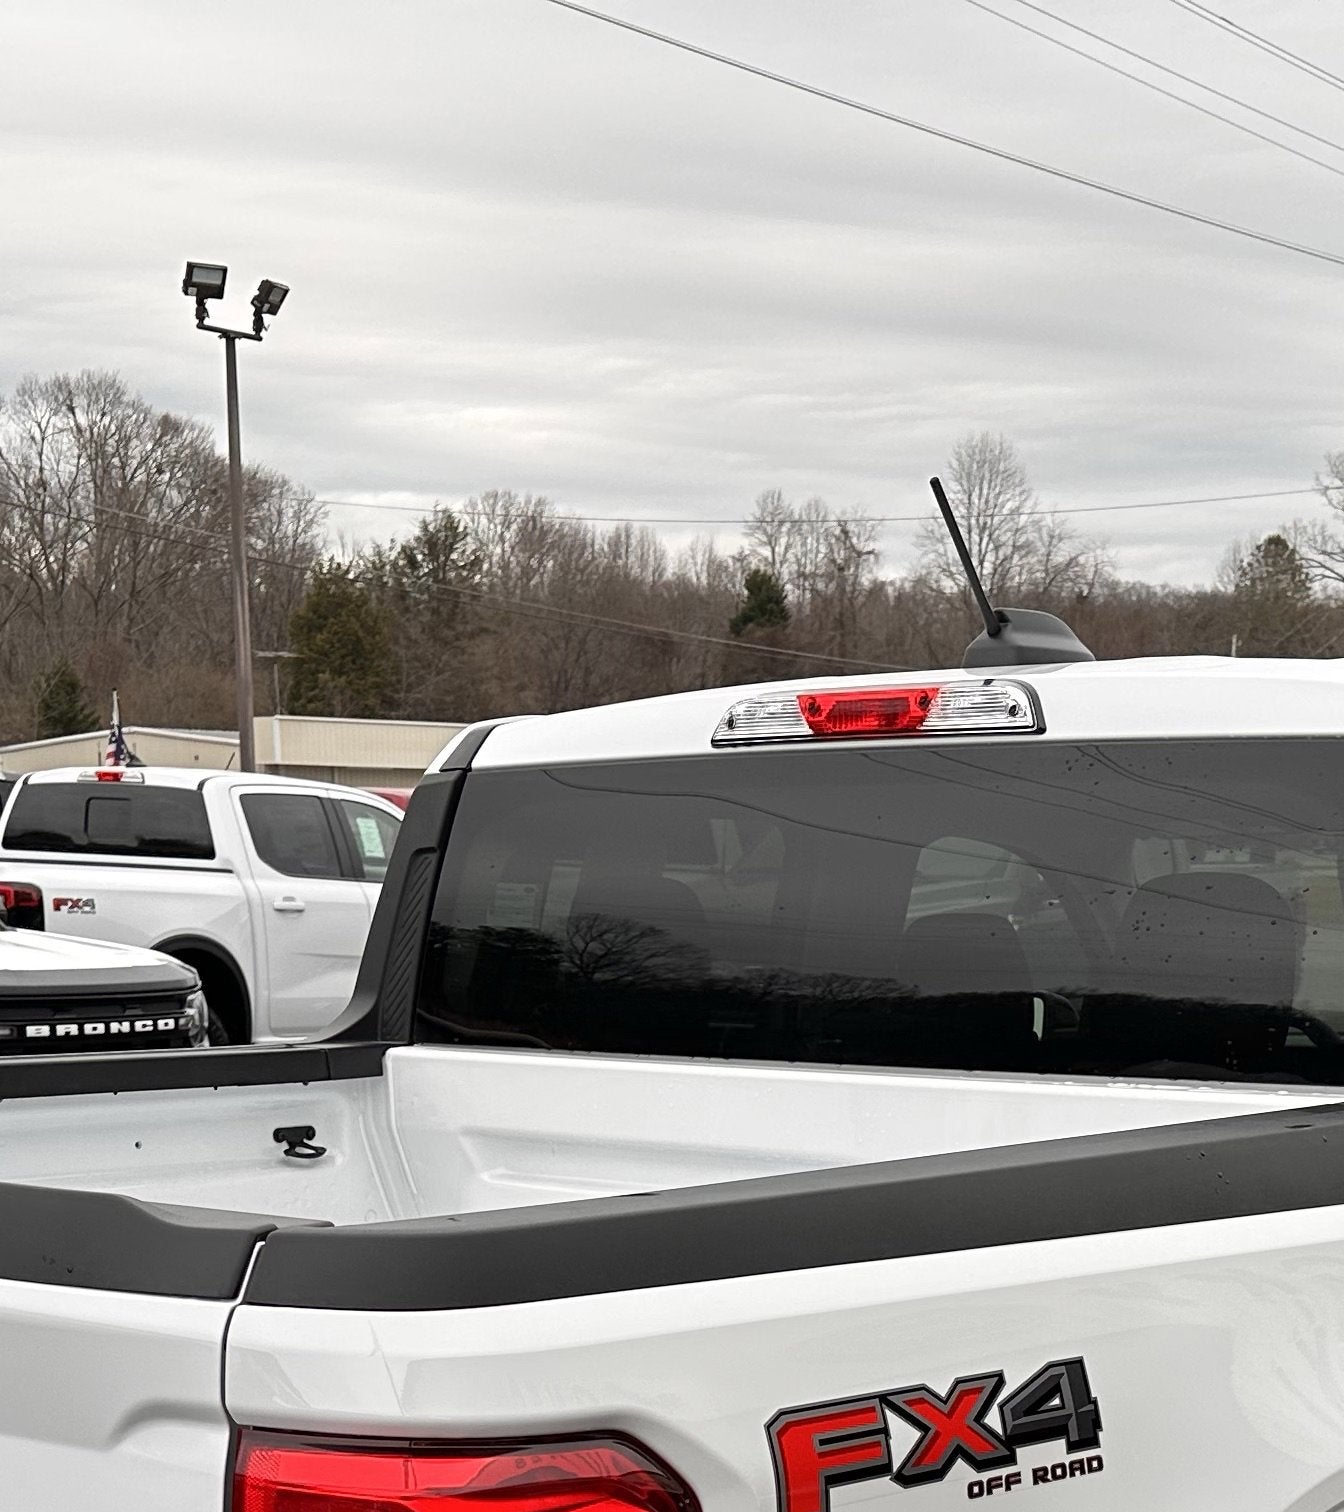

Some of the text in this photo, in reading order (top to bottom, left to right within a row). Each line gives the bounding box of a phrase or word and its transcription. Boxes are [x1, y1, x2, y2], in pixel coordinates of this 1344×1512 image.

[53, 898, 95, 911] FX4
[26, 1018, 175, 1038] BRONCO
[967, 1454, 1104, 1500] OFF ROAD
